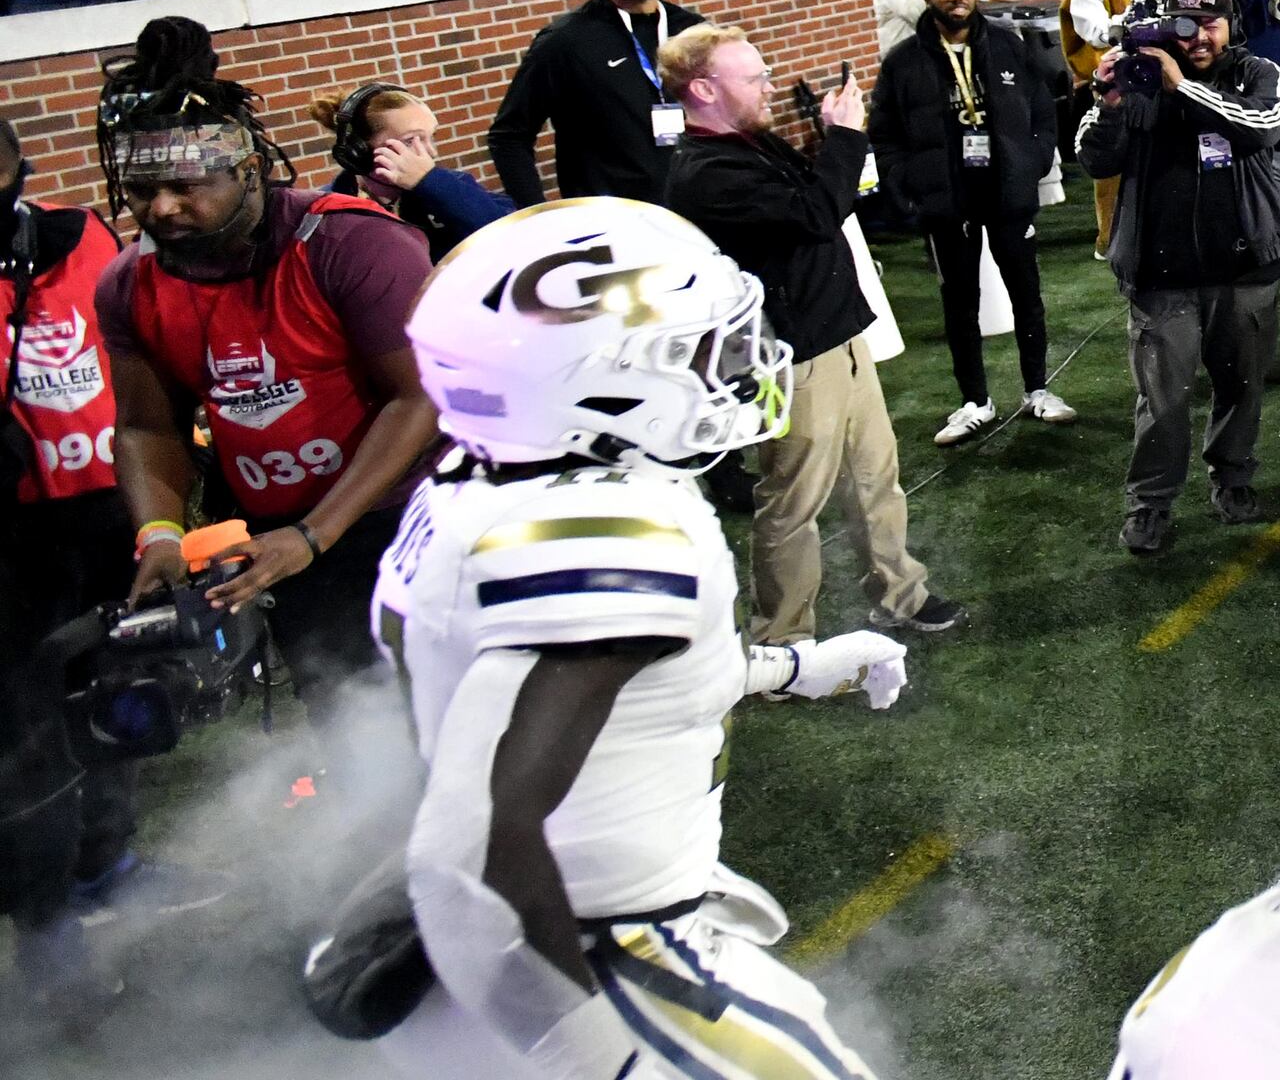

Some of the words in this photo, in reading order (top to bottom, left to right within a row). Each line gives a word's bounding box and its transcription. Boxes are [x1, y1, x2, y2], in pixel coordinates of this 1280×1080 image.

[1202, 136, 1211, 147] 5
[215, 356, 261, 373] ESPN
[17, 366, 100, 393] COLLEGE
[35, 383, 95, 400] FOOTBALL
[229, 398, 290, 415] FOOTBALL
[235, 437, 344, 490] 039
